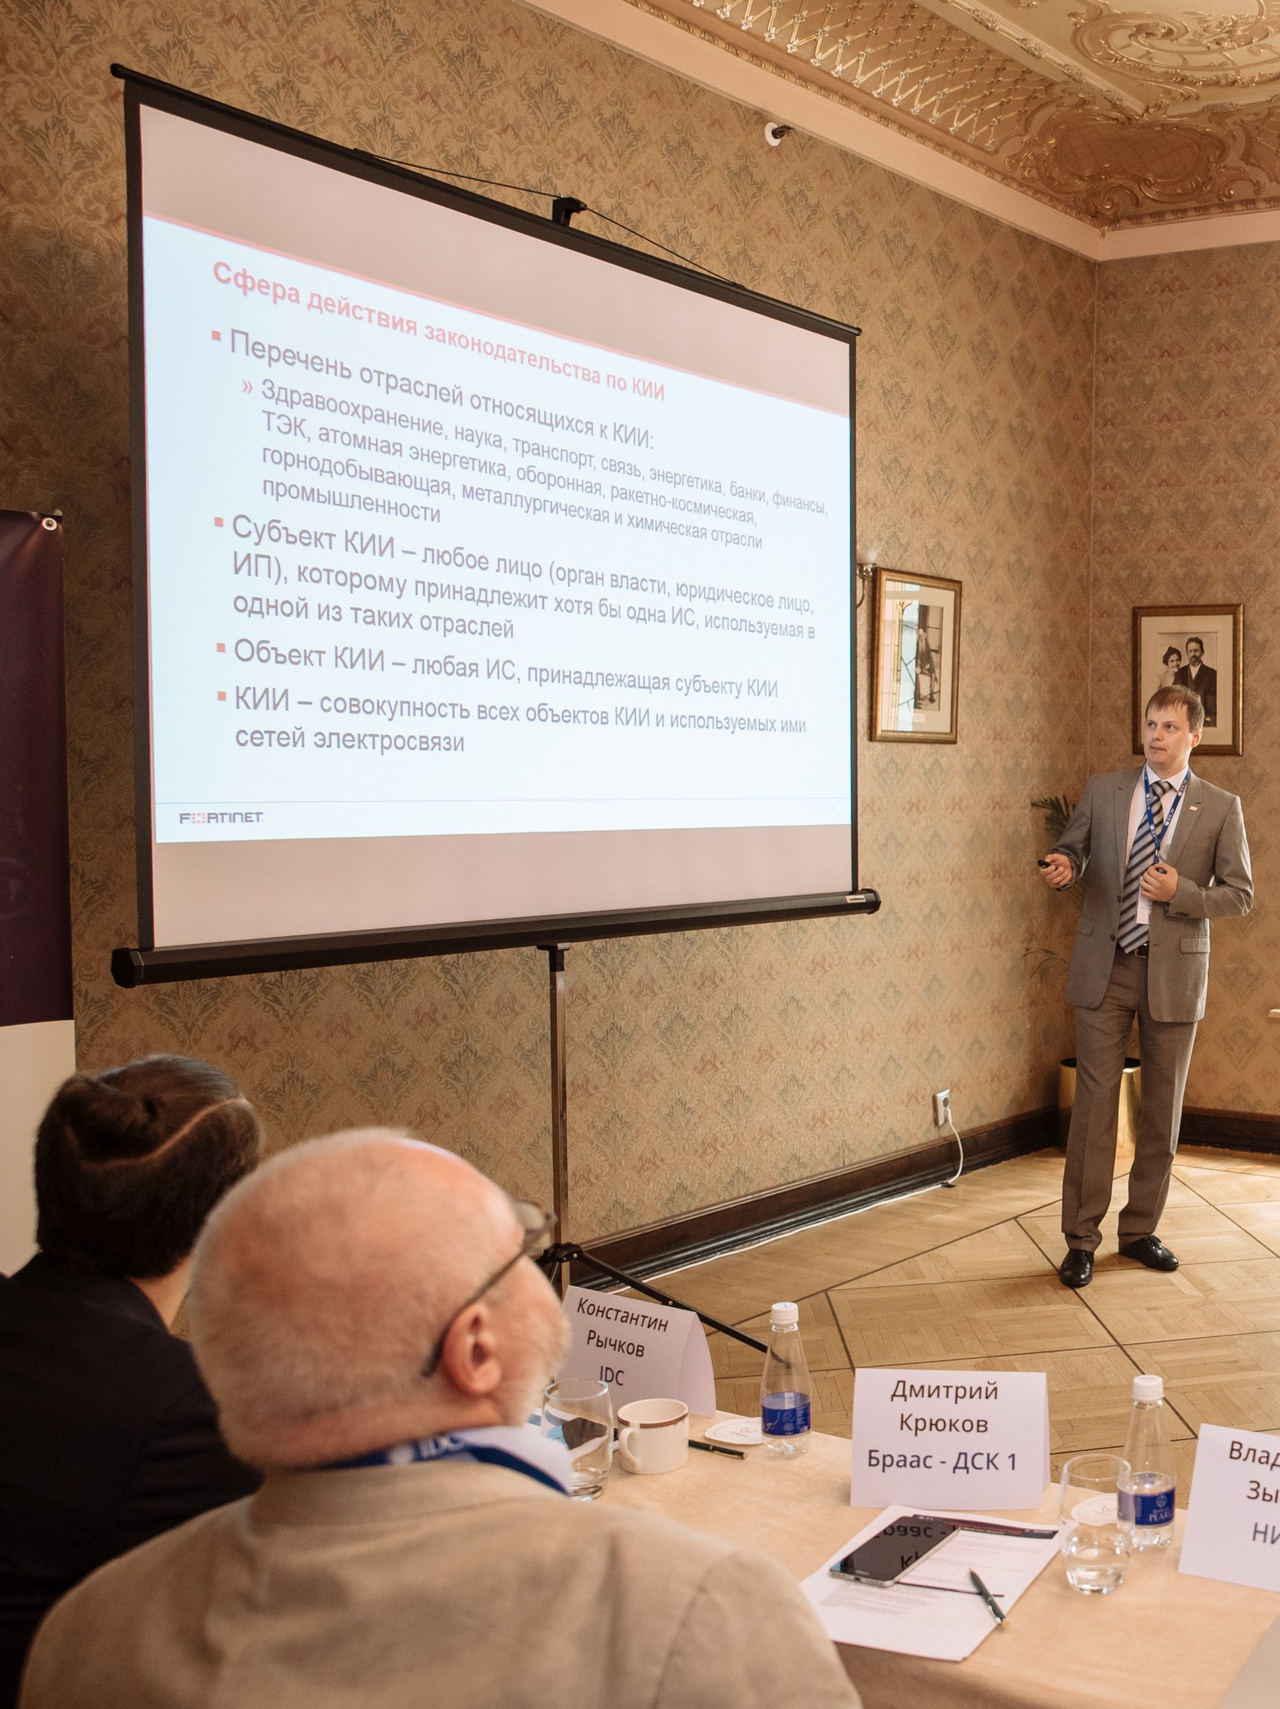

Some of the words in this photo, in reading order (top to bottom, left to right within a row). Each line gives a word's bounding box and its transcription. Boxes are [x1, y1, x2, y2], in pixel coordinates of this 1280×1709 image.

[213, 261, 299, 304] Сфера
[307, 292, 417, 336] действия
[425, 325, 600, 384] законодательства
[606, 373, 627, 390] по
[632, 376, 664, 400] КИИ
[231, 328, 352, 379] Перечень
[359, 367, 463, 406] отраслей
[470, 393, 593, 436] относящихся
[599, 423, 608, 439] к
[613, 421, 653, 449] КИИ:
[261, 378, 447, 440] Здравоохранение,
[454, 425, 506, 453] наука,
[512, 437, 596, 471] транспорт,
[601, 457, 644, 481] связь,
[649, 467, 725, 497] энергетика,
[729, 480, 768, 505] банки,
[772, 490, 827, 517] финансы,
[261, 409, 310, 442] ТЭК,
[318, 426, 402, 457] атомная
[409, 445, 510, 481] энергетика,
[516, 464, 605, 499] оборонная,
[610, 485, 756, 527] ракетно-космическая,
[262, 447, 455, 499] горнодобывающая,
[462, 484, 609, 523] металлургическая
[614, 512, 622, 525] и
[627, 514, 707, 539] химическая
[710, 529, 762, 549] отрасли
[263, 479, 440, 523] промышленности
[232, 514, 336, 550] Субъект
[344, 529, 394, 558] КИИ
[421, 546, 489, 571] любое
[495, 557, 542, 582] лицо
[549, 560, 604, 587] (орган
[610, 573, 670, 598] власти,
[676, 582, 774, 608] юридическое
[777, 596, 813, 615] лицо,
[233, 550, 287, 585] ИП),
[297, 565, 407, 599] которому
[414, 580, 548, 610] принадлежит
[553, 597, 592, 615] хотя
[598, 597, 620, 618] бы
[626, 605, 665, 624] одна
[671, 606, 698, 629] ИС,
[704, 614, 803, 639] используемая
[807, 626, 815, 639] в
[233, 595, 308, 619] одной
[317, 603, 342, 622] из
[349, 606, 413, 629] таких
[419, 614, 513, 638] отраслей
[234, 638, 326, 667] Объект
[334, 645, 384, 671] КИИ
[412, 654, 479, 678] любая
[486, 658, 520, 683] ИС,
[527, 666, 670, 694] принадлежащая
[675, 674, 742, 699] субъекту
[747, 678, 777, 697] КИИ
[235, 686, 288, 711] КИИ
[320, 696, 470, 721] совокупность
[477, 704, 519, 721] всех
[525, 702, 609, 725] объектов
[615, 706, 649, 726] КИИ
[655, 713, 664, 727] и
[670, 714, 776, 734] используемых
[780, 719, 805, 732] ими
[235, 725, 305, 748] сетей
[313, 731, 464, 755] электросвязи
[179, 811, 263, 824] FORTINET
[576, 1297, 669, 1334] Константин
[587, 1329, 645, 1357] Рычков
[600, 1365, 625, 1386] IDC
[890, 1380, 999, 1402] Дмитрий
[899, 1413, 989, 1434] Крюков
[868, 1449, 933, 1473] Браас
[952, 1452, 999, 1474] ДСК
[1008, 1453, 1015, 1470] 1
